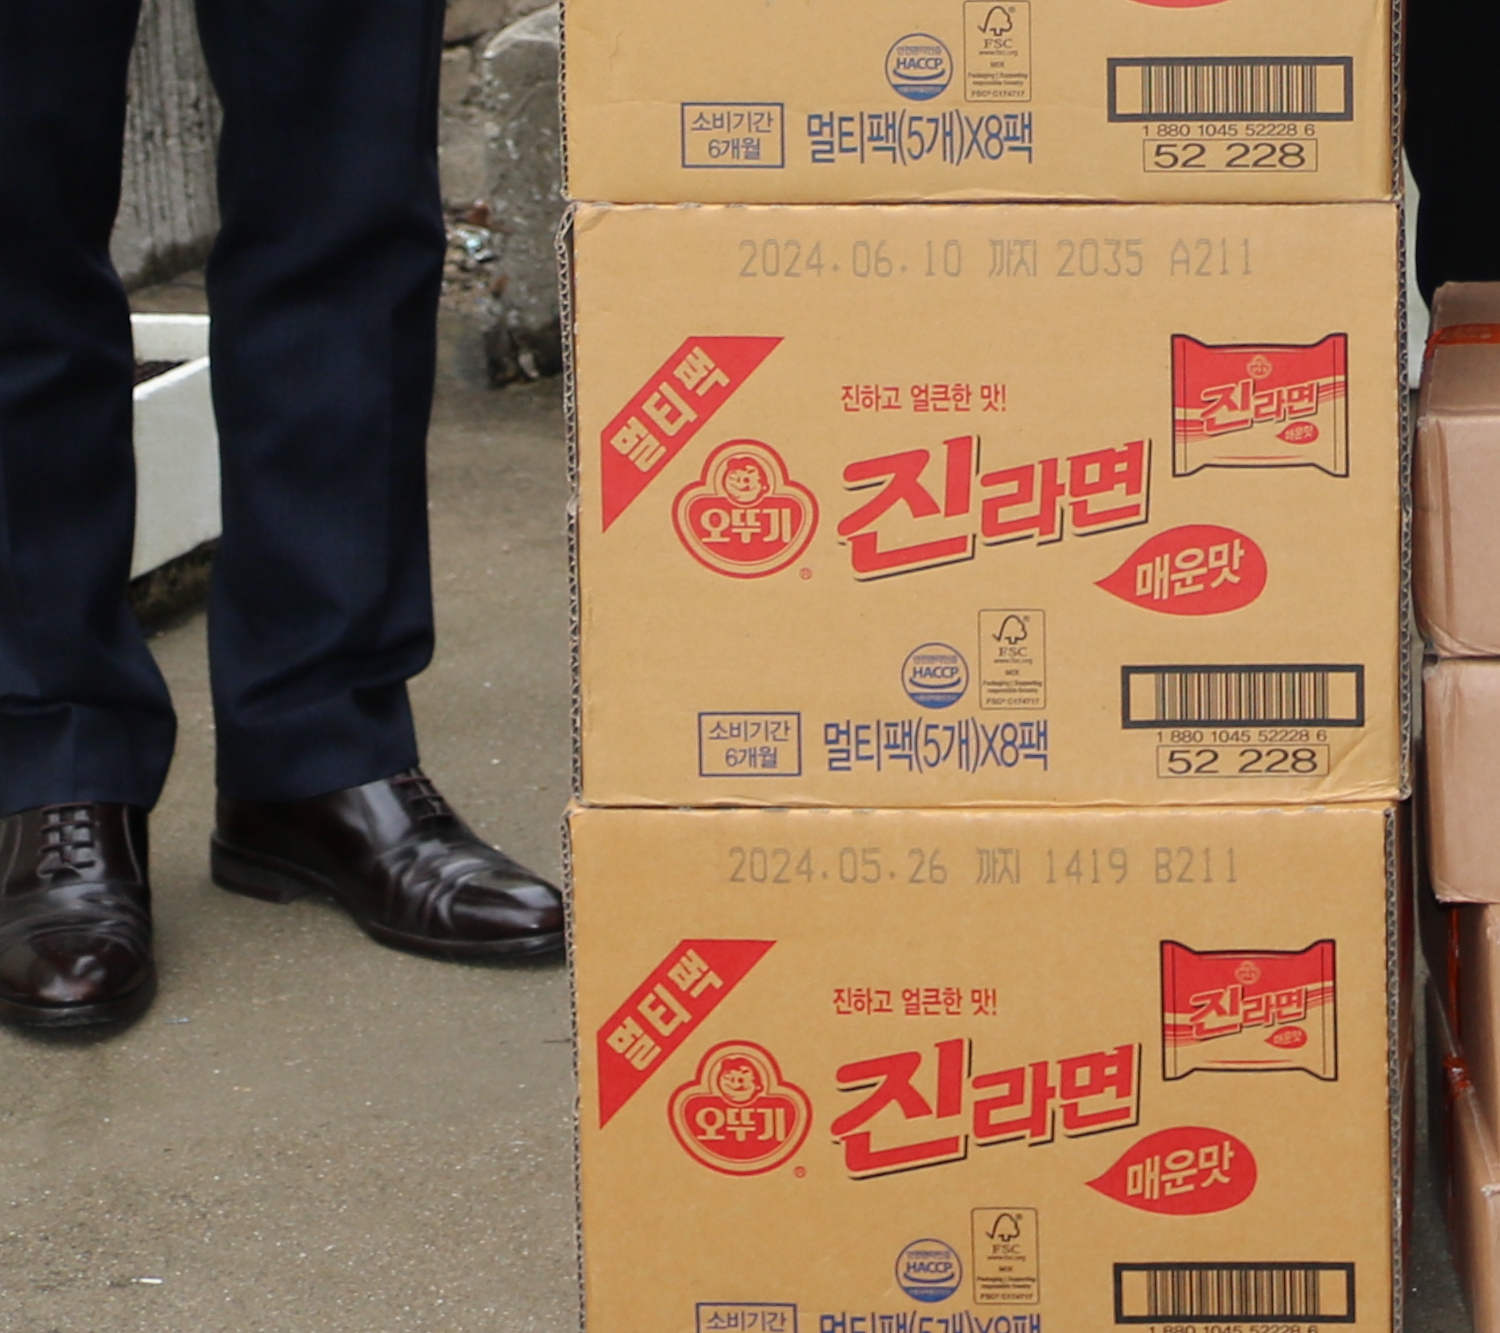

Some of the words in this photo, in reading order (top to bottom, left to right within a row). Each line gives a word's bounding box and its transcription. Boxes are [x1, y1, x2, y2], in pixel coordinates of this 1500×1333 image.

[896, 57, 943, 70] HACCP
[691, 111, 773, 133] 소비기간
[807, 109, 1032, 166] 멀티팩(5개)X8팩
[1156, 124, 1191, 137] 880
[1198, 124, 1238, 137] 1045
[1245, 124, 1298, 137] 52228
[708, 137, 760, 160] 6개월
[1153, 143, 1207, 170] 52
[1224, 143, 1307, 170] 228
[739, 238, 962, 278] 2024.06.10
[1057, 239, 1143, 278] 2035
[1170, 238, 1253, 276] A211
[612, 347, 730, 470] 멀티팩
[842, 383, 902, 412] 진하고
[910, 382, 973, 411] 얼큰한
[981, 383, 1005, 411] 맛!
[1198, 377, 1320, 438] 진라면
[836, 433, 1155, 584] 진라면
[700, 508, 793, 545] 오뚜기
[1132, 537, 1244, 598] 매운맛
[912, 666, 959, 679] HACCP
[708, 720, 790, 742] 소비기간
[823, 717, 1048, 773] 멀티팩(5개)X8팩
[1170, 730, 1205, 744] 880
[1211, 730, 1251, 743] 1045
[1258, 730, 1311, 743] 52228
[725, 745, 777, 768] 6개월
[1167, 749, 1221, 775] 52
[1238, 748, 1319, 775] 228
[728, 847, 947, 884] 2024.05.26
[1046, 848, 1128, 884] 1419
[1155, 847, 1237, 883] B211
[608, 951, 723, 1070] 멀티팩
[834, 987, 893, 1014] 진하고
[902, 987, 963, 1015] 얼큰한
[971, 988, 996, 1015] 맛!
[1187, 983, 1309, 1043] 진라면
[695, 1107, 787, 1143] 오뚜기
[830, 1036, 1146, 1183] 진라면
[1123, 1138, 1234, 1198] 매운맛
[906, 1261, 953, 1273] HACCP
[706, 1311, 787, 1333] 소비기간
